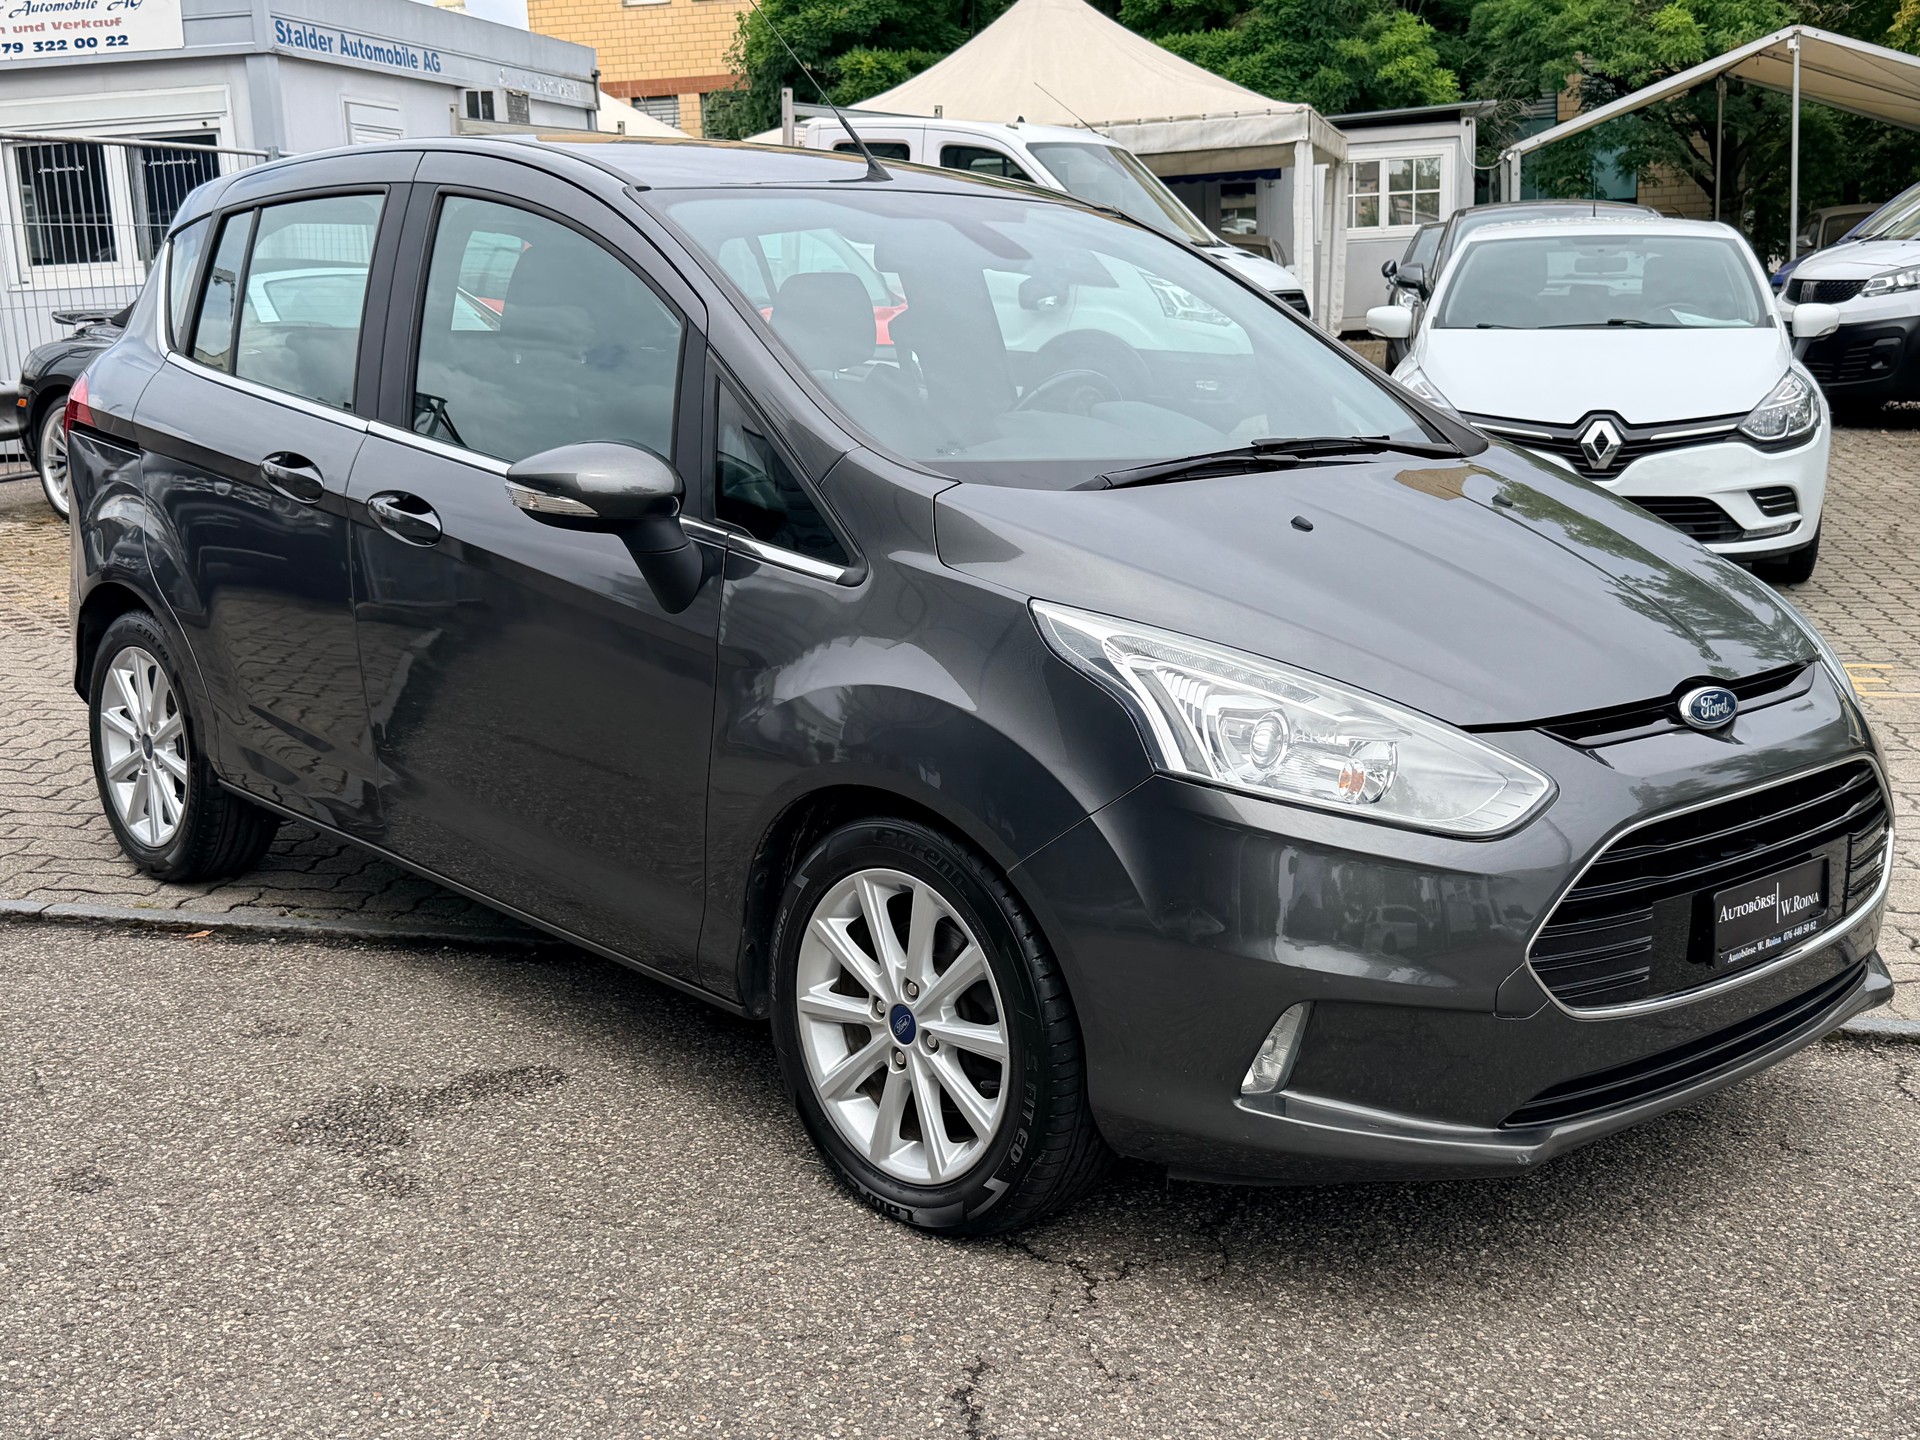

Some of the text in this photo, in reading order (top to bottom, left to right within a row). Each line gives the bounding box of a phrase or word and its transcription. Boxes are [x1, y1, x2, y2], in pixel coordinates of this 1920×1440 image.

[8, 0, 98, 18] Automobile
[13, 22, 45, 33] und
[51, 17, 122, 30] Verkauf
[33, 40, 68, 52] 322
[74, 37, 98, 49] 00
[105, 35, 129, 46] 22
[275, 20, 441, 73] Stalder Automobile AG
[1700, 693, 1730, 719] Ford
[1718, 893, 1776, 923] AUTOBÖRSE
[1727, 946, 1757, 963] Autobörse
[1757, 942, 1764, 951] W.
[1765, 937, 1781, 948] Roina
[1783, 930, 1793, 941] 076
[1793, 925, 1802, 937] 440
[1810, 920, 1817, 931] 82
